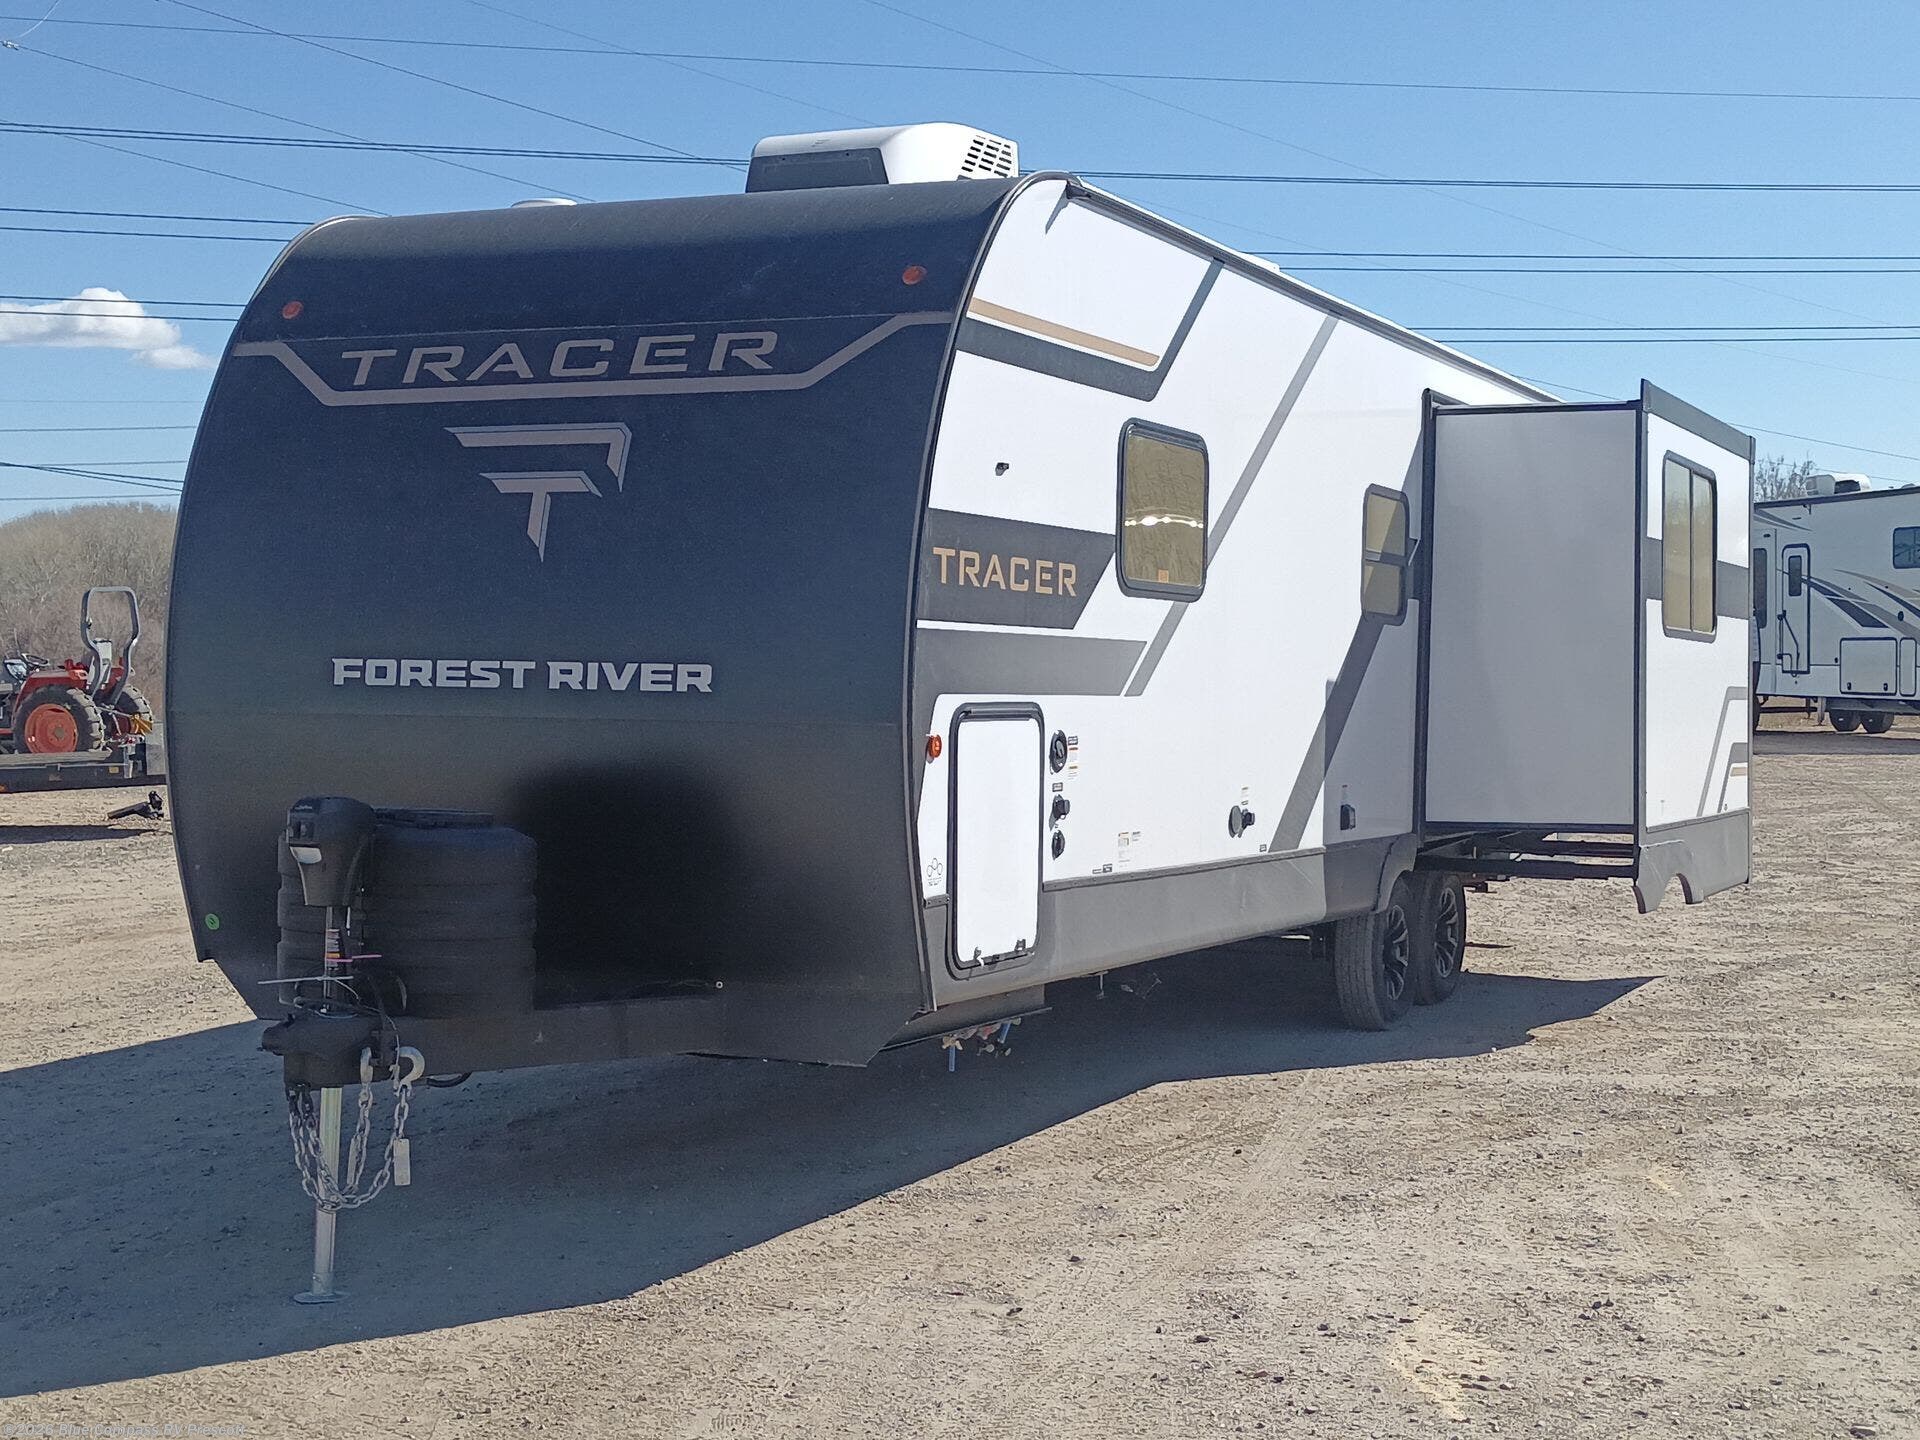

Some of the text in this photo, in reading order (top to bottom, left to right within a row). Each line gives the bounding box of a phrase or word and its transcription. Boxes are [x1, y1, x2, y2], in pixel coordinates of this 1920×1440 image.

[341, 331, 778, 386] TRACER
[932, 547, 1078, 597] TRACER
[331, 657, 713, 693] FOREST RIVER
